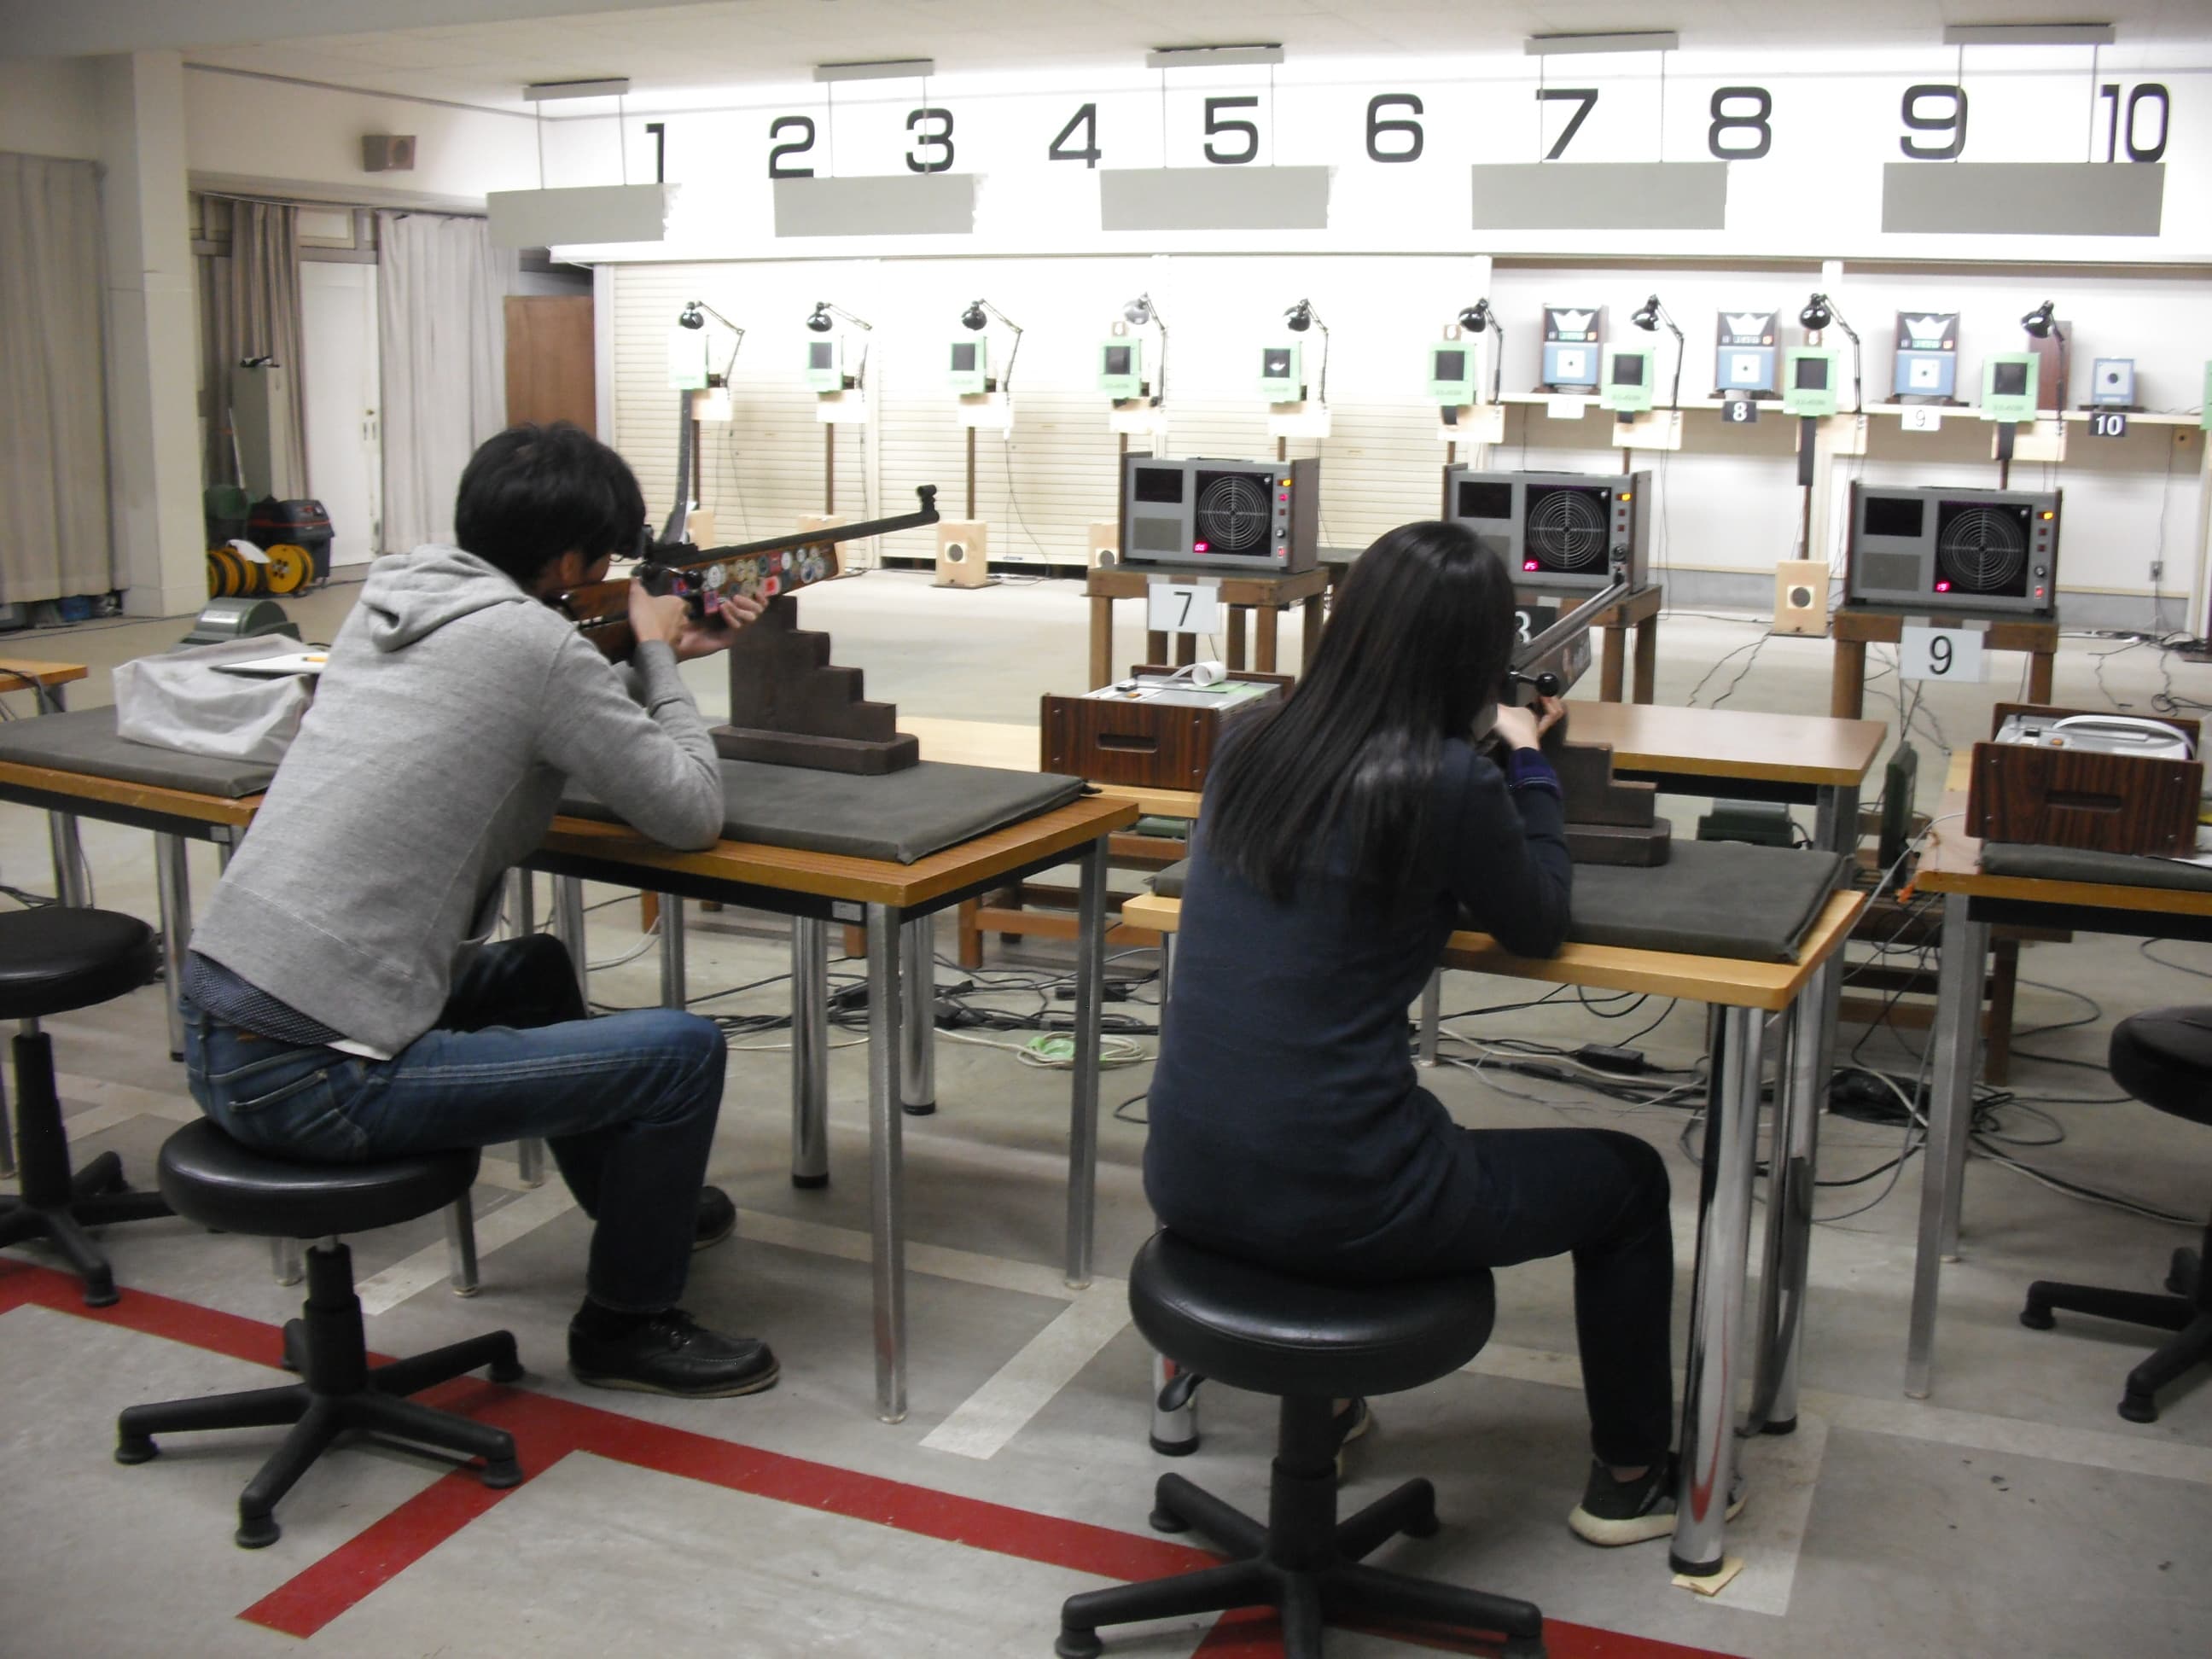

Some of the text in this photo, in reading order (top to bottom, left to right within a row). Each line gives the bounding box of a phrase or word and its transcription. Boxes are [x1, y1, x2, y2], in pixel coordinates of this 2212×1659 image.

[646, 123, 665, 183] 1
[769, 116, 815, 179] 2
[906, 108, 954, 173] 3
[1049, 103, 1101, 168] 4
[1204, 96, 1259, 165] 5
[1366, 94, 1423, 162] 6
[1535, 89, 1598, 160] 7
[1708, 87, 1772, 160] 8
[1900, 84, 1968, 160] 9
[2101, 83, 2170, 163] 10
[1733, 402, 1747, 422] 8
[1916, 410, 1926, 427] 9
[2096, 416, 2123, 435] 10
[1174, 591, 1192, 626] 7
[1930, 636, 1952, 674] 9
